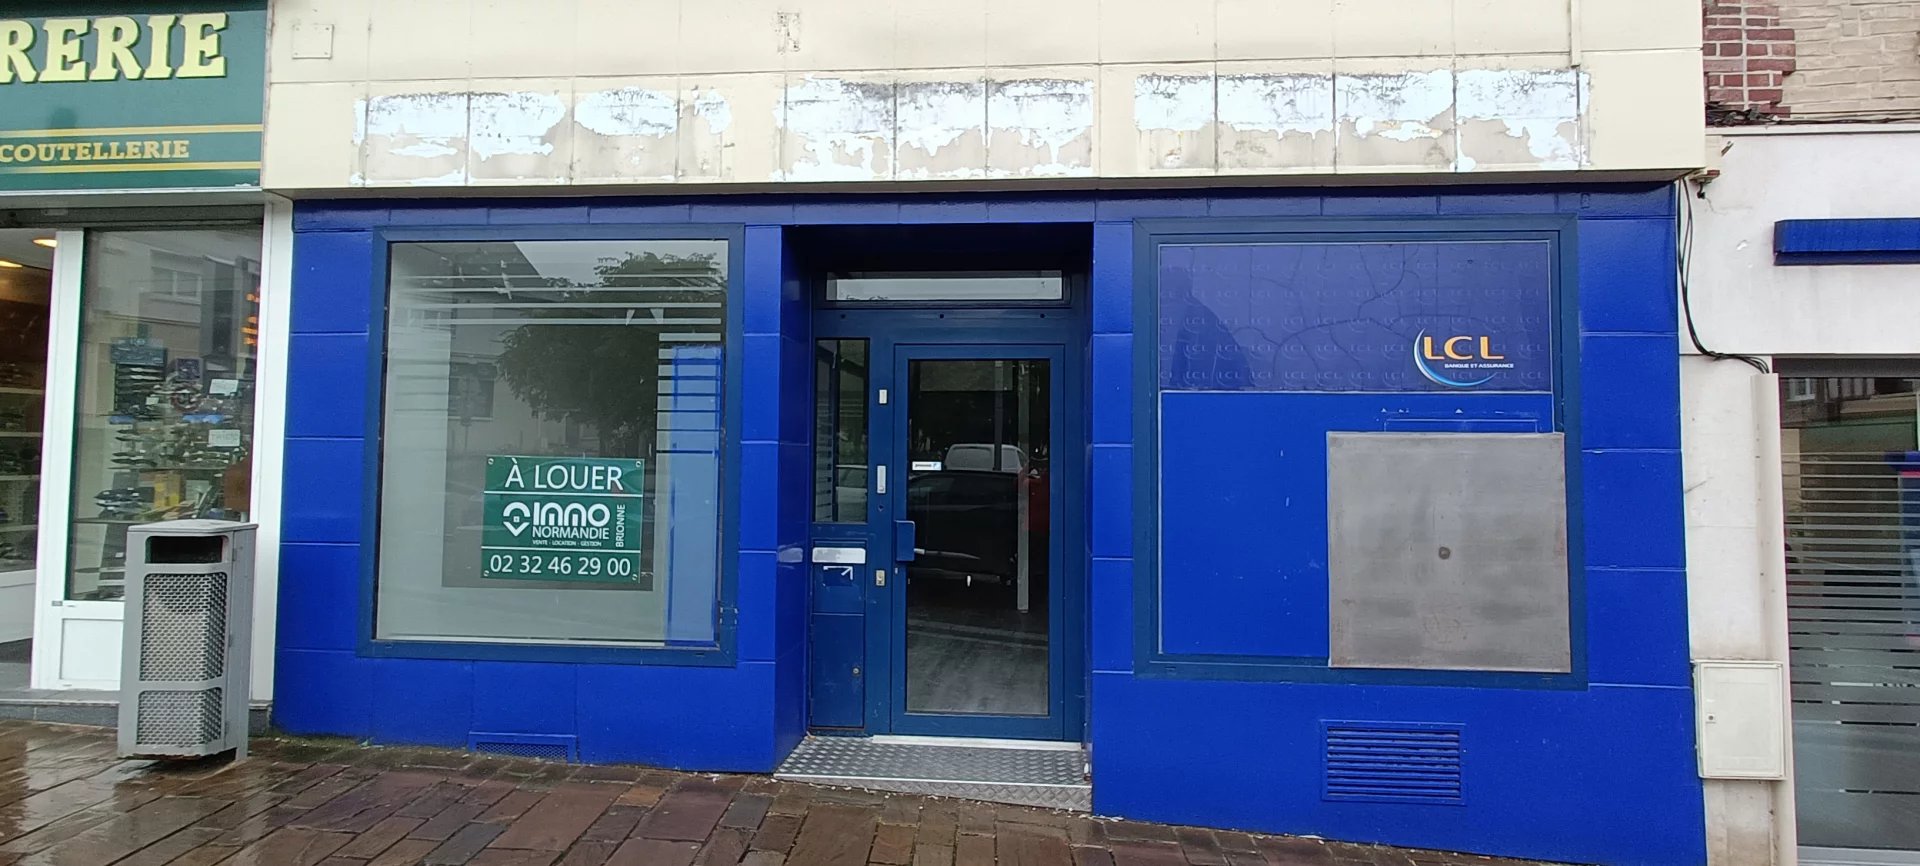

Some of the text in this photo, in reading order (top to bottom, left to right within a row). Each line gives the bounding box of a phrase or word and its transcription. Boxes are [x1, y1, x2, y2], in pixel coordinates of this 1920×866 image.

[0, 140, 190, 163] COUTELLERIE
[1423, 335, 1505, 360] LCL
[504, 457, 624, 491] À LOUER
[532, 526, 610, 540] NORMANDIE
[615, 503, 626, 548] BRIONNE
[490, 554, 631, 576] 02 32 46 29 00
